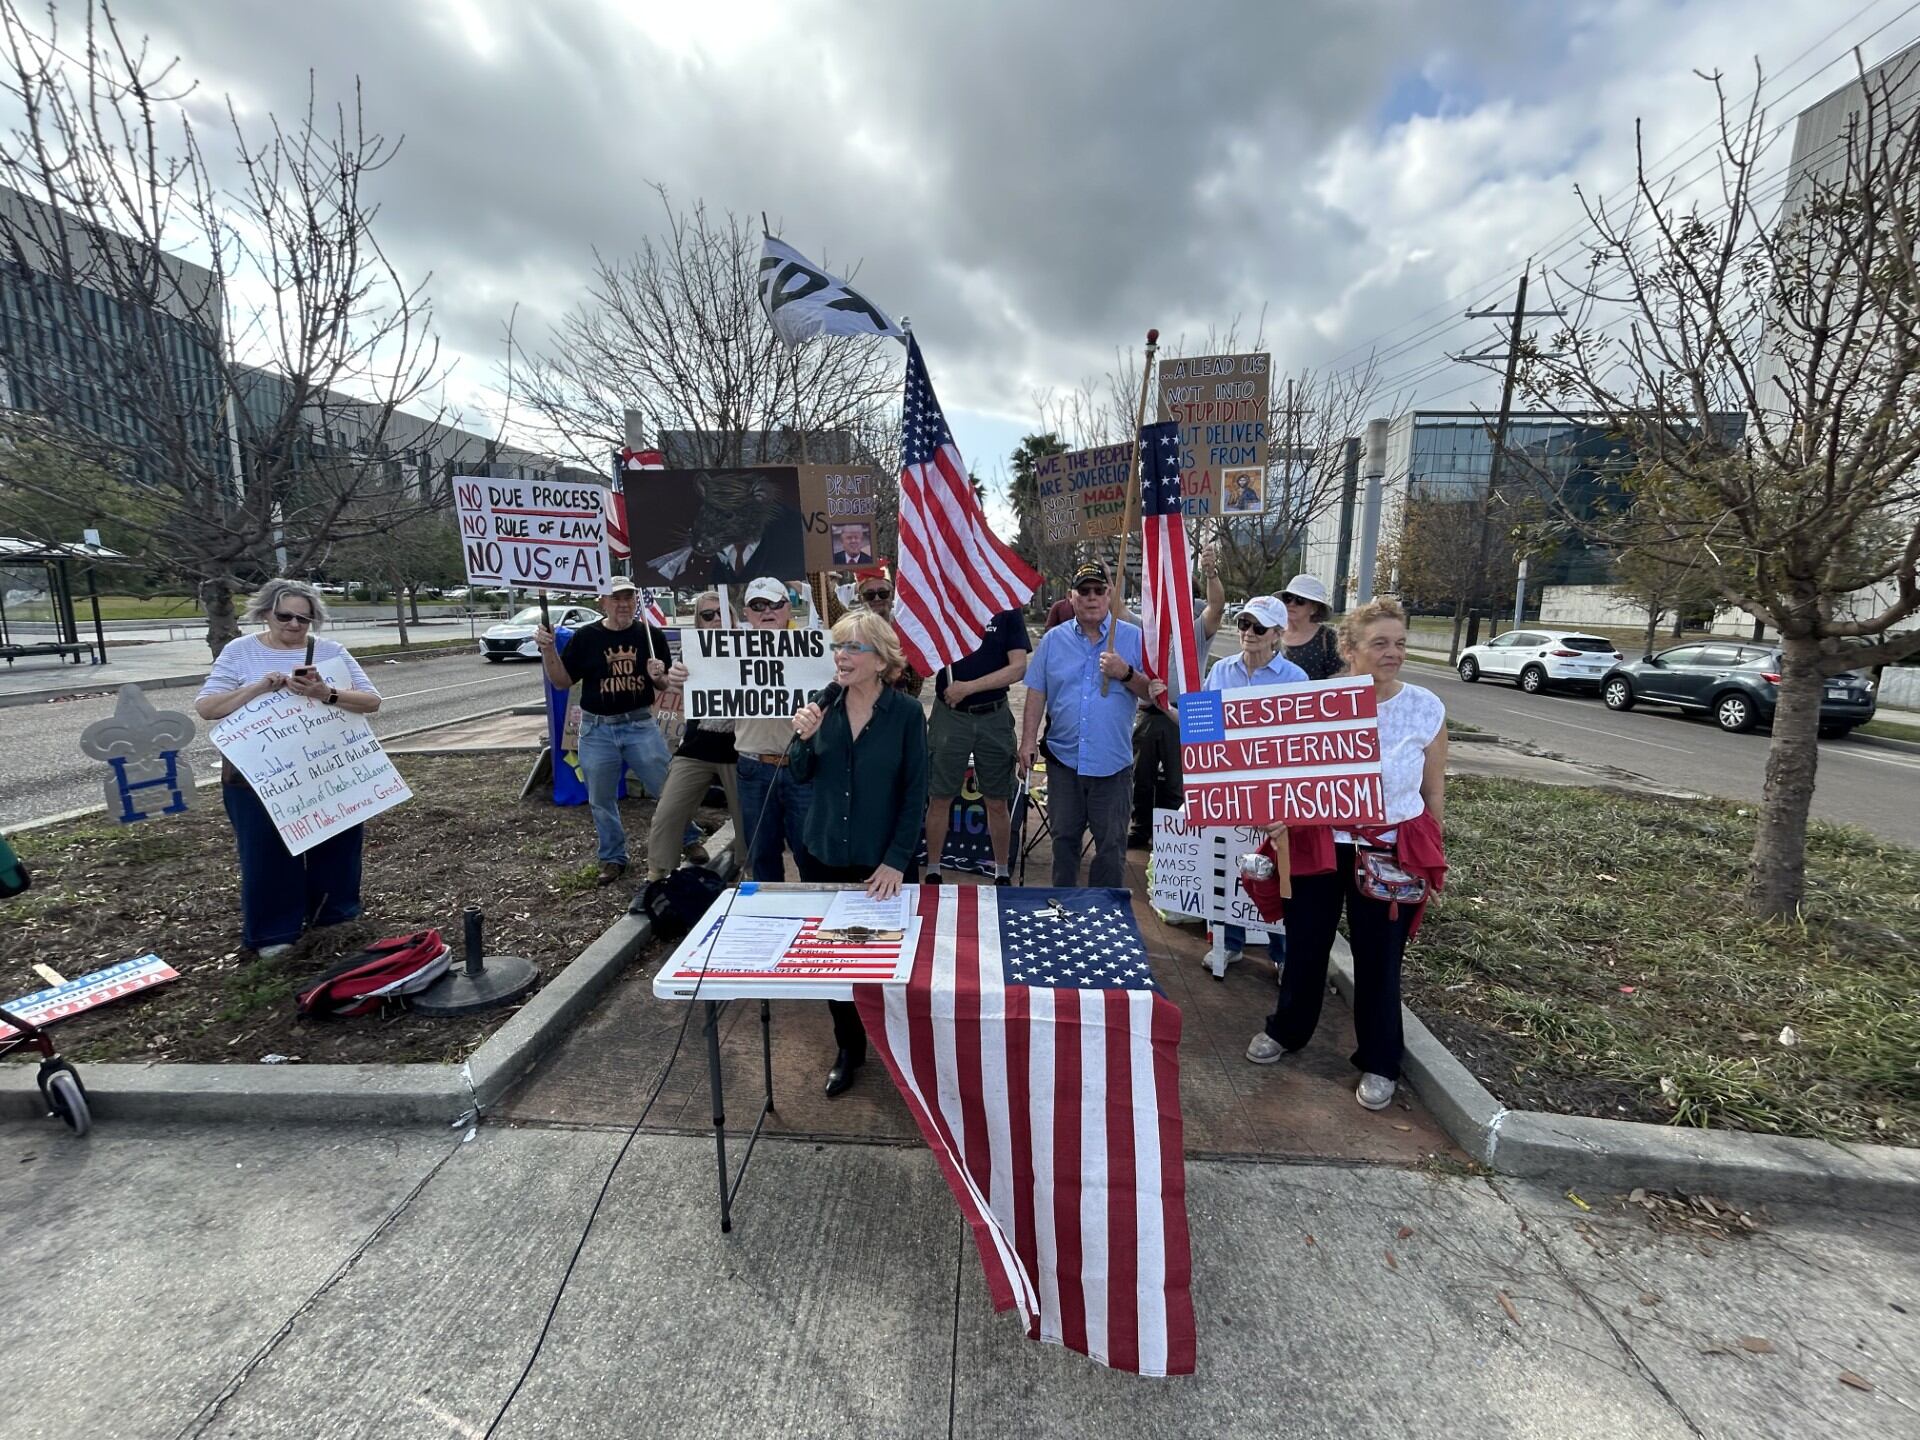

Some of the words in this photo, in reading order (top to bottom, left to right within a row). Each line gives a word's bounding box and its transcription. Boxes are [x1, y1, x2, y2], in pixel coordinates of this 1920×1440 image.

[1190, 357, 1234, 378] LEAD
[1241, 356, 1267, 374] US
[1167, 385, 1204, 404] NOT
[1215, 380, 1255, 399] INTO
[1169, 396, 1266, 424] STUPIDITY
[1206, 423, 1267, 445] DELIVER
[1066, 451, 1089, 470] THE
[1093, 444, 1135, 466] PEOPLE
[1210, 446, 1257, 466] FROM
[825, 474, 871, 495] DRAFT
[1040, 477, 1063, 498] ARE
[1067, 463, 1131, 492] SOVEREIGN
[458, 483, 482, 509] NO
[488, 486, 523, 508] DUE
[533, 486, 604, 514] PROCESS,
[827, 497, 877, 518] DODGER
[1043, 493, 1079, 513] NOT
[1083, 485, 1124, 504] MAGA
[1180, 498, 1209, 515] MEN
[802, 511, 828, 534] VS
[1046, 506, 1080, 526] NOT
[463, 515, 488, 537] NO
[495, 516, 529, 538] RULE
[538, 521, 554, 535] OF
[560, 521, 604, 543] LAW,
[1048, 522, 1081, 542] NOT
[467, 541, 502, 574] NO
[513, 546, 552, 580] US
[554, 556, 570, 569] OF
[570, 549, 606, 586] A!
[698, 630, 824, 658] VETERANS
[611, 659, 634, 676] NO
[739, 659, 786, 687] FOR
[600, 675, 645, 693] KINGS
[657, 710, 678, 720] FOR
[692, 688, 819, 717] DEMOCRA
[1224, 689, 1366, 727] RESPECT
[216, 715, 272, 747] Supreme
[272, 705, 302, 719] Law
[257, 725, 300, 742] Three
[298, 708, 346, 735] Branches
[302, 741, 336, 761] Executive
[1184, 743, 1233, 770] OUR
[259, 777, 294, 799] Article
[308, 760, 335, 780] Article
[344, 744, 370, 763] Article
[1185, 784, 1259, 821] FIGHT
[1268, 776, 1385, 821] FASCISM!
[271, 802, 285, 821] A
[279, 815, 314, 844] THAT
[1155, 842, 1200, 856] WANTS
[1156, 859, 1197, 872] MASS
[1154, 875, 1202, 891] LAYOFFS
[1155, 889, 1163, 897] AT
[1164, 890, 1178, 901] THE
[1179, 889, 1205, 914] VA!
[1, 956, 152, 1010] DEMOCRAC
[23, 970, 142, 1014] DEFENDING
